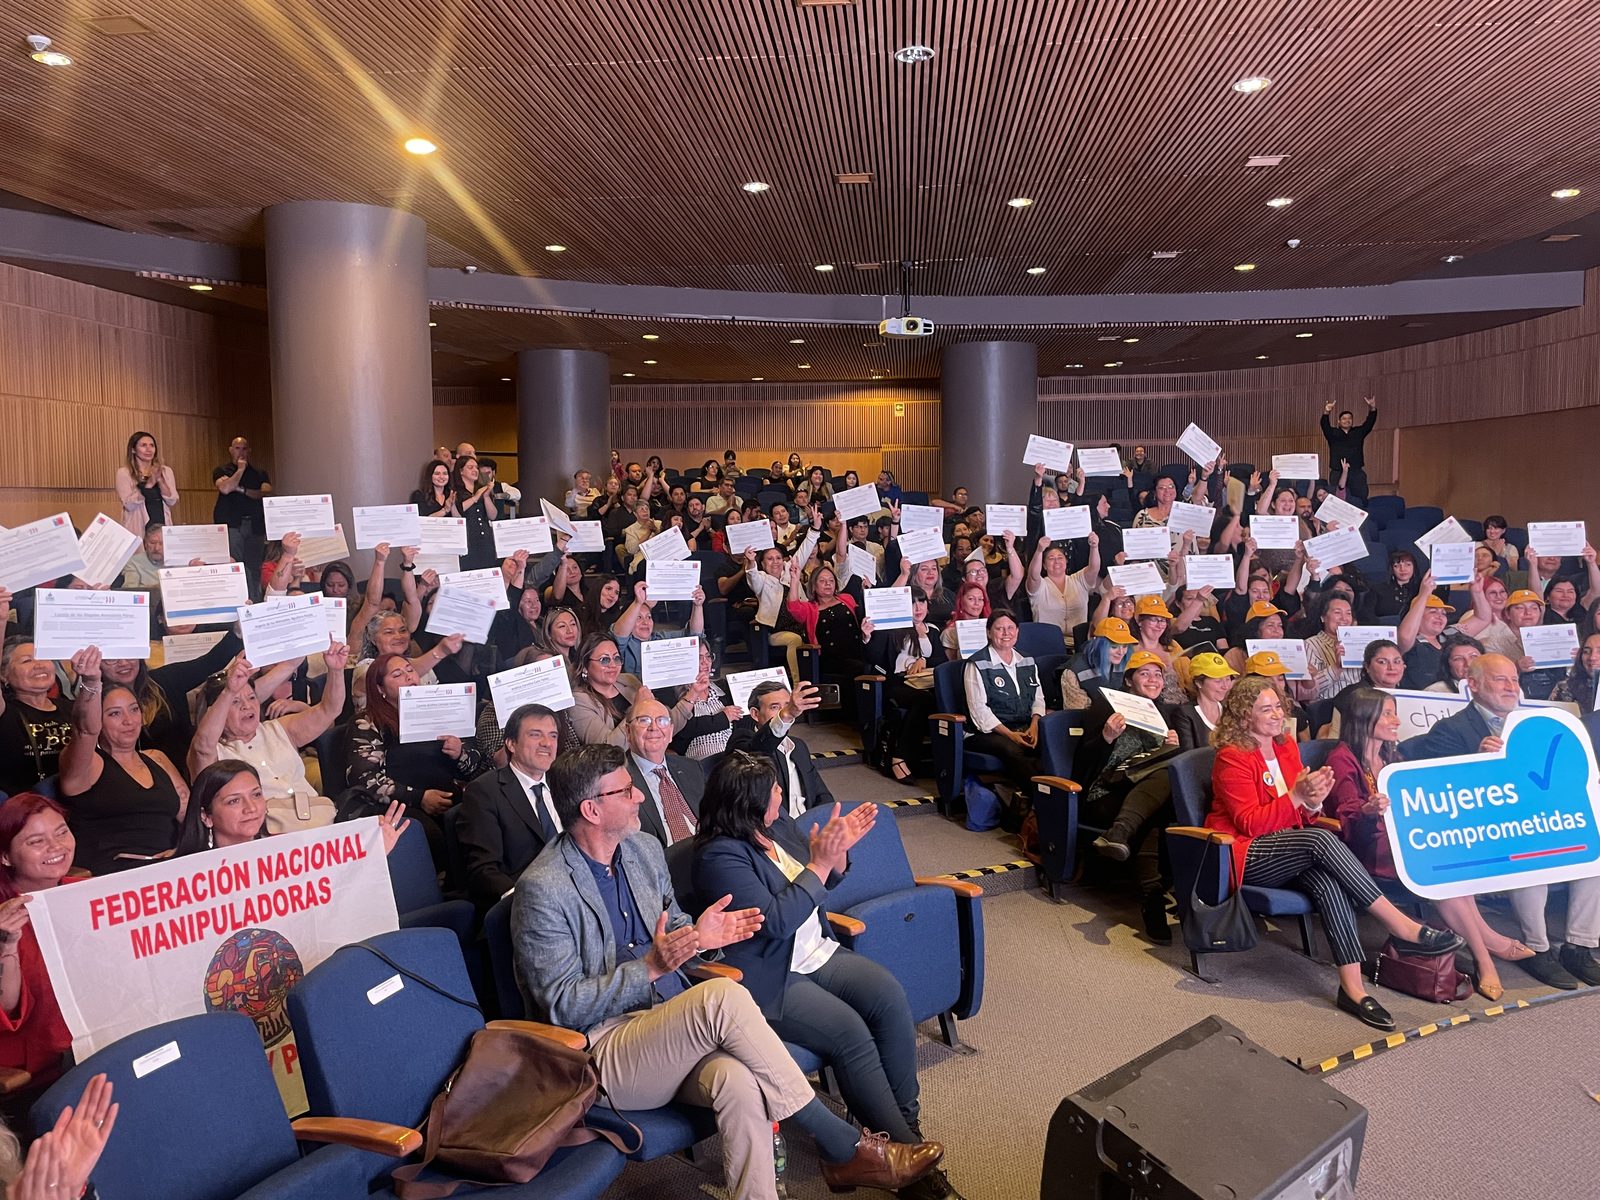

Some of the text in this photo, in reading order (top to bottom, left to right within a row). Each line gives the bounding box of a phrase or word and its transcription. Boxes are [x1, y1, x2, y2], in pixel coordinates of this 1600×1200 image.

[1401, 783, 1519, 820] Mujeres
[1408, 810, 1587, 850] Comprometidas
[89, 833, 368, 931] FEDERACIÓN NACIONAL
[130, 876, 332, 960] MANIPULADORAS
